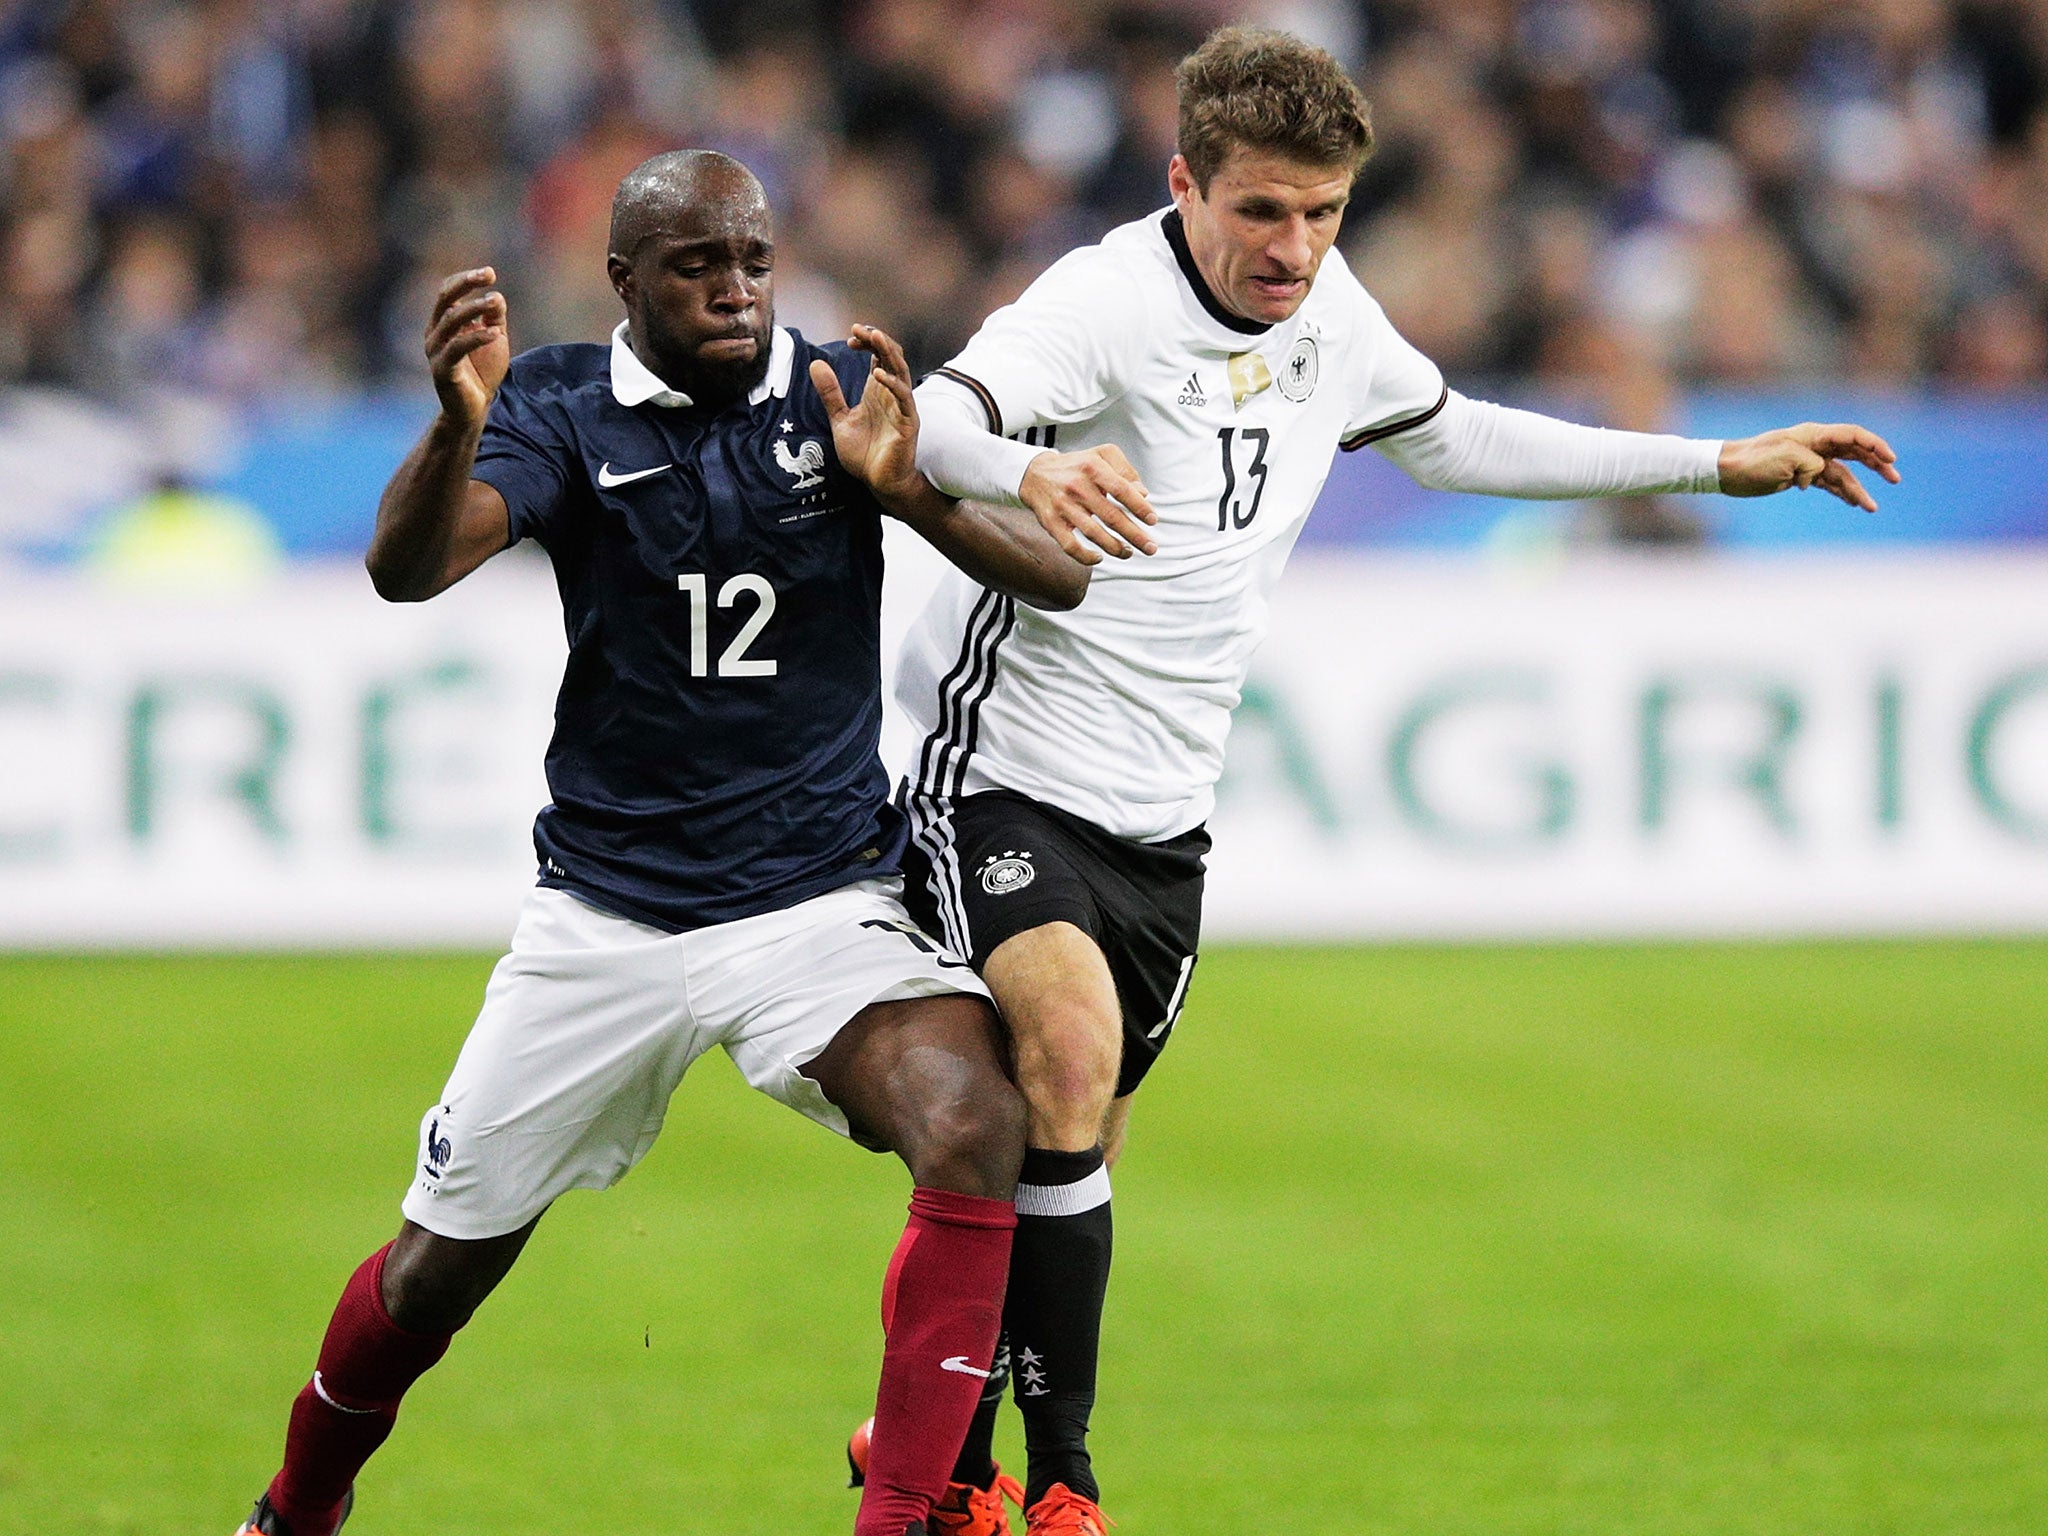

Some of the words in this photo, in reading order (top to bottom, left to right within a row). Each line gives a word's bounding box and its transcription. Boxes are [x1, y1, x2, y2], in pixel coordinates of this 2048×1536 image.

[1216, 427, 1270, 532] 13
[677, 573, 777, 677] 12
[1147, 954, 1195, 1039] 1
